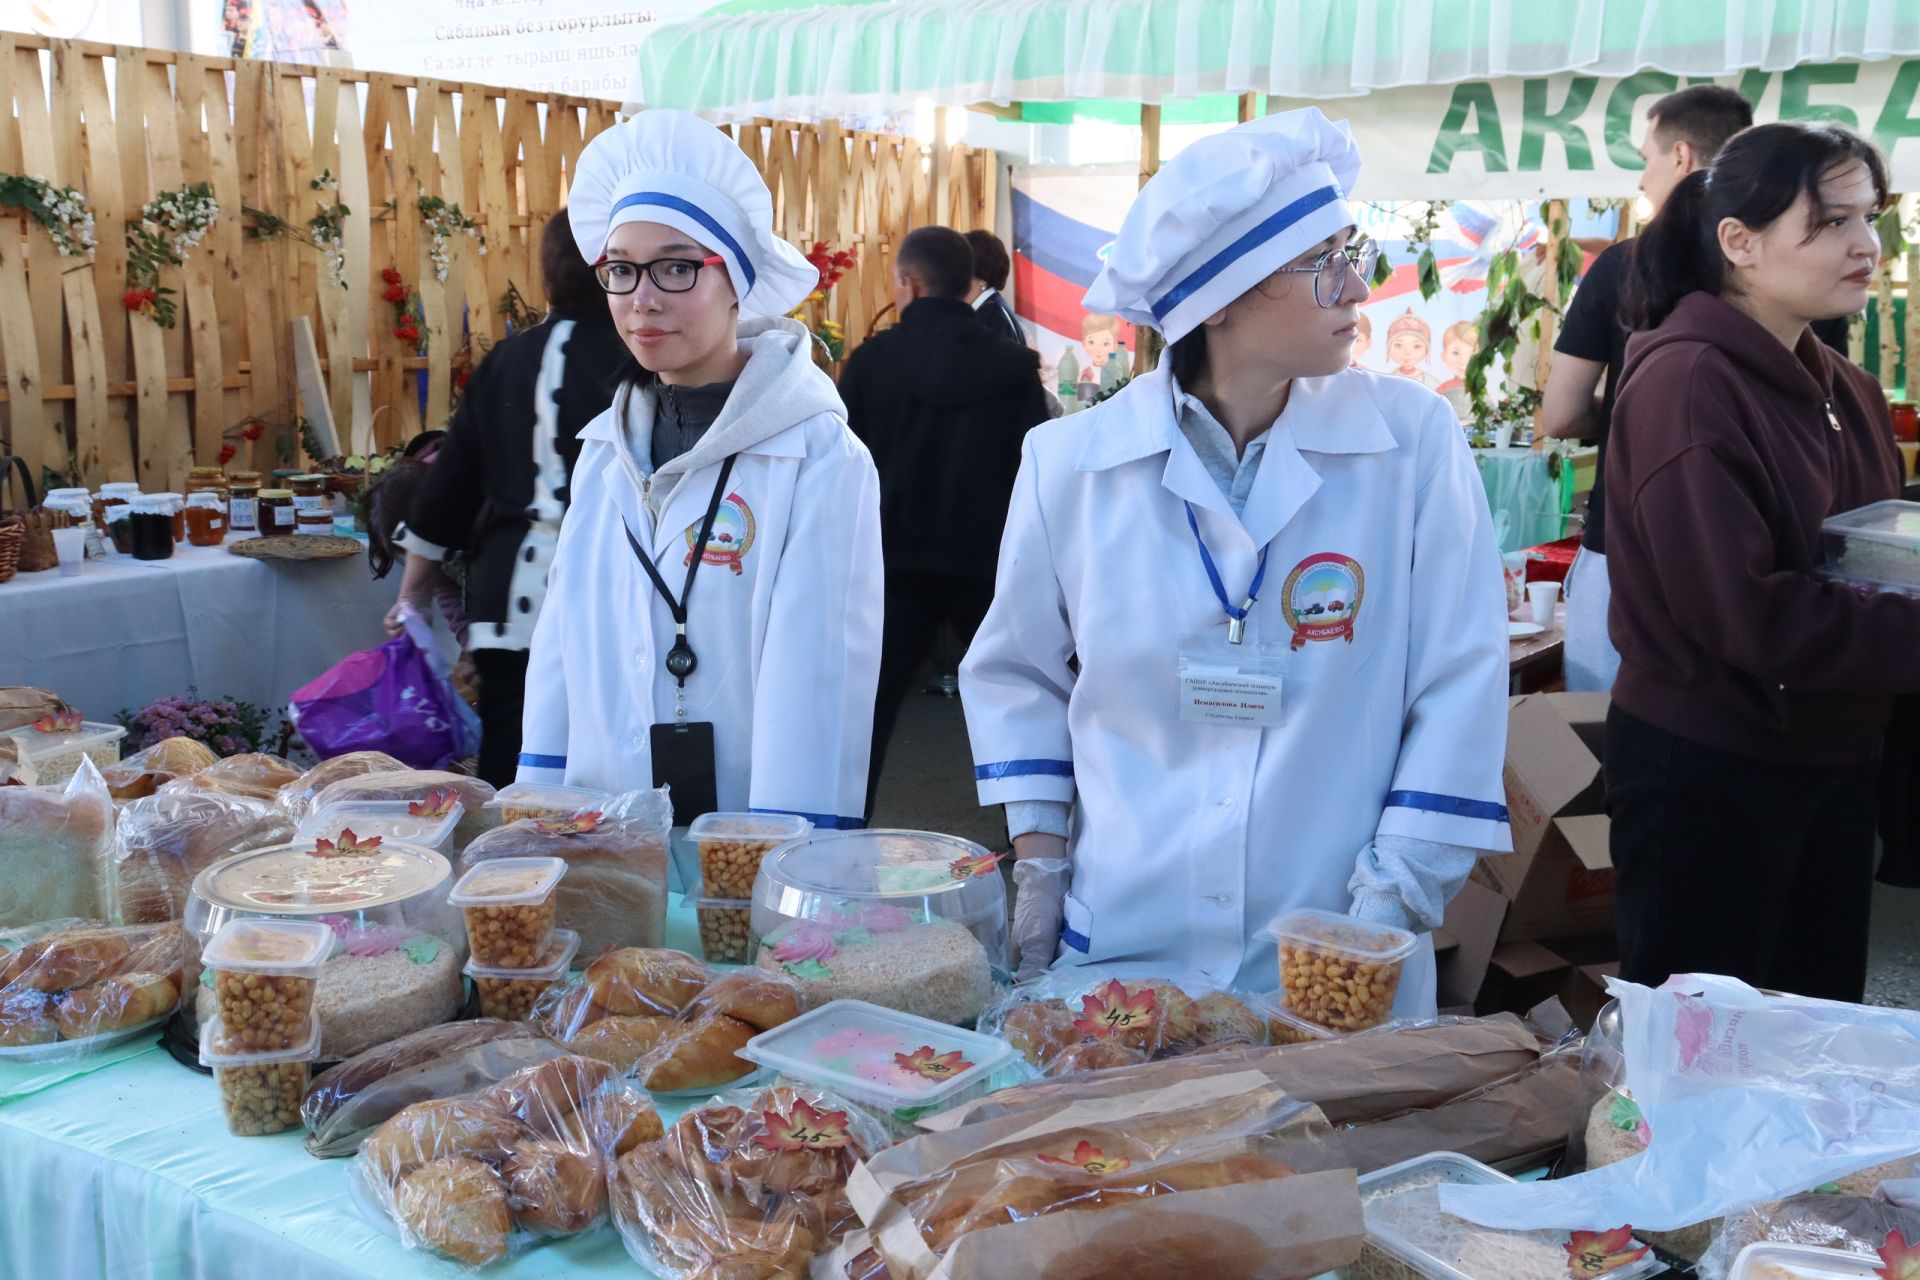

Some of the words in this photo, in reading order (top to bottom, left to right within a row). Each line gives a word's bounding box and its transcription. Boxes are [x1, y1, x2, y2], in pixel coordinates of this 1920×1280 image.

[434, 23, 510, 41] Сабаның
[516, 18, 544, 34] без
[504, 48, 571, 69] тырыш
[577, 42, 639, 61] яшьлә
[561, 73, 628, 97] барабы
[1306, 625, 1345, 636] АКСУБАЕВО
[1106, 1008, 1136, 1029] 45
[791, 1127, 832, 1142] 45
